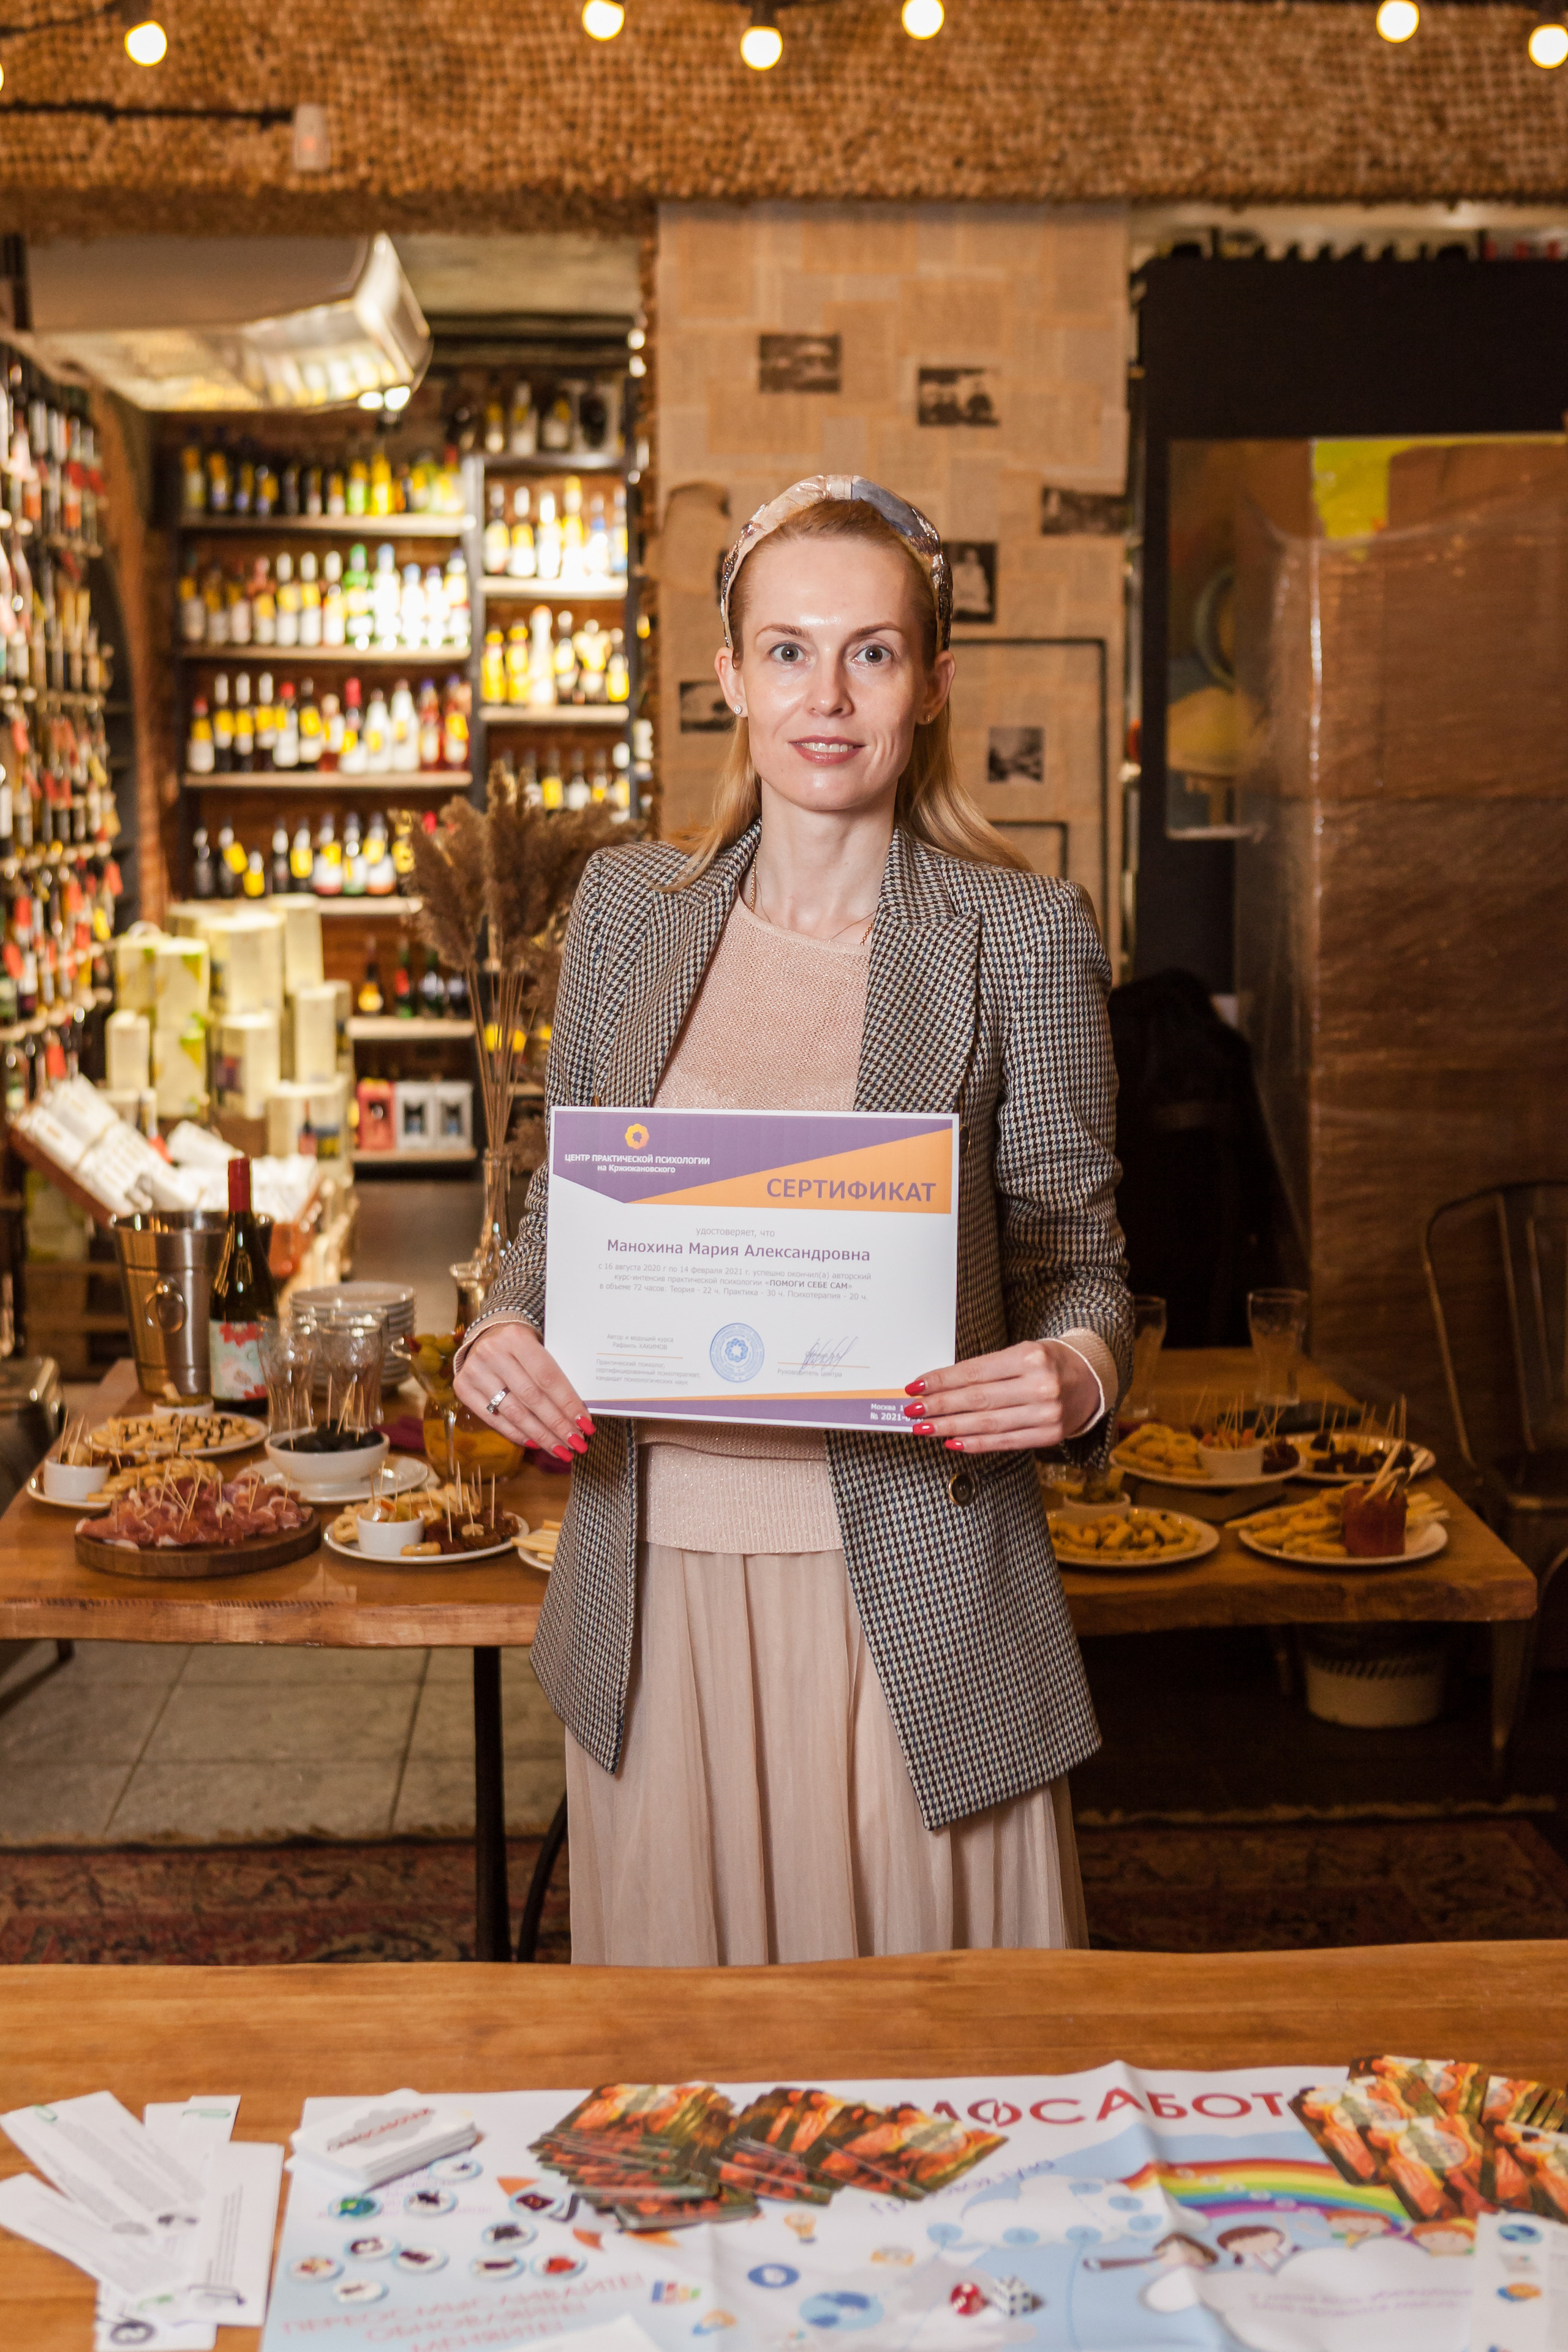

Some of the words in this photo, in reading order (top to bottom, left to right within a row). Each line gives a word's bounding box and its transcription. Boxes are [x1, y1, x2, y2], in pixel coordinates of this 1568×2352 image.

[565, 1153, 590, 1162] ЦЕНТР
[592, 1154, 654, 1163] ПРАКТИЧЕСКОЙ
[655, 1156, 710, 1165] ПСИХОЛОГИИ
[609, 1164, 676, 1173] Кржижановского
[766, 1177, 937, 1202] СЕРТИФИКАТ
[696, 1227, 757, 1237] удостоверяет,
[607, 1238, 684, 1254] Манохина
[688, 1242, 739, 1258] Мария
[744, 1244, 870, 1262] Александровна
[615, 1264, 641, 1273] августа
[691, 1266, 722, 1275] февраля
[787, 1270, 830, 1280] окончил(а)
[832, 1272, 872, 1281] авторский
[668, 1276, 717, 1284] практической
[723, 1287, 758, 1296] Практика
[788, 1290, 841, 1300] Психотерапия
